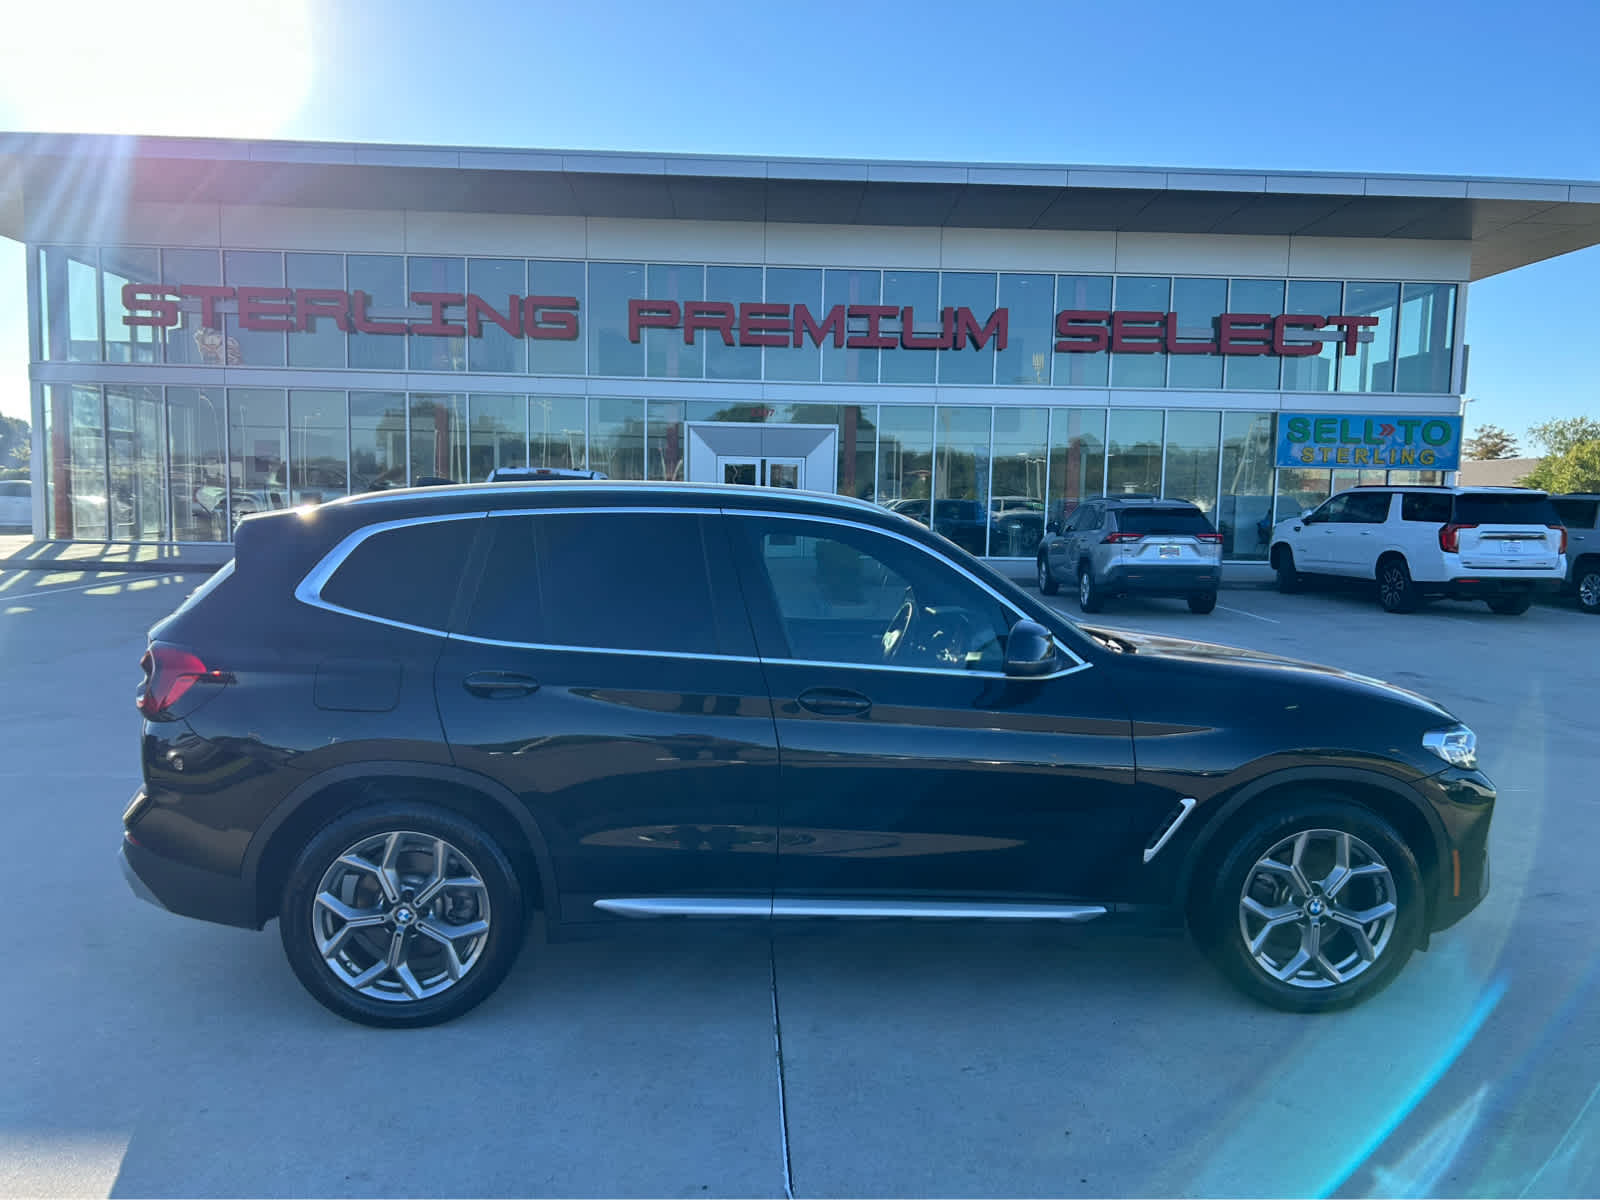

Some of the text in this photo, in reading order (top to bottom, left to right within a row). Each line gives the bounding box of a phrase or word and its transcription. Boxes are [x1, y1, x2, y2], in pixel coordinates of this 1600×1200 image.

[122, 283, 1379, 356] STERLING PREMIUM SELECT
[1287, 417, 1452, 446] SELL TO
[1301, 447, 1435, 465] STERLING
